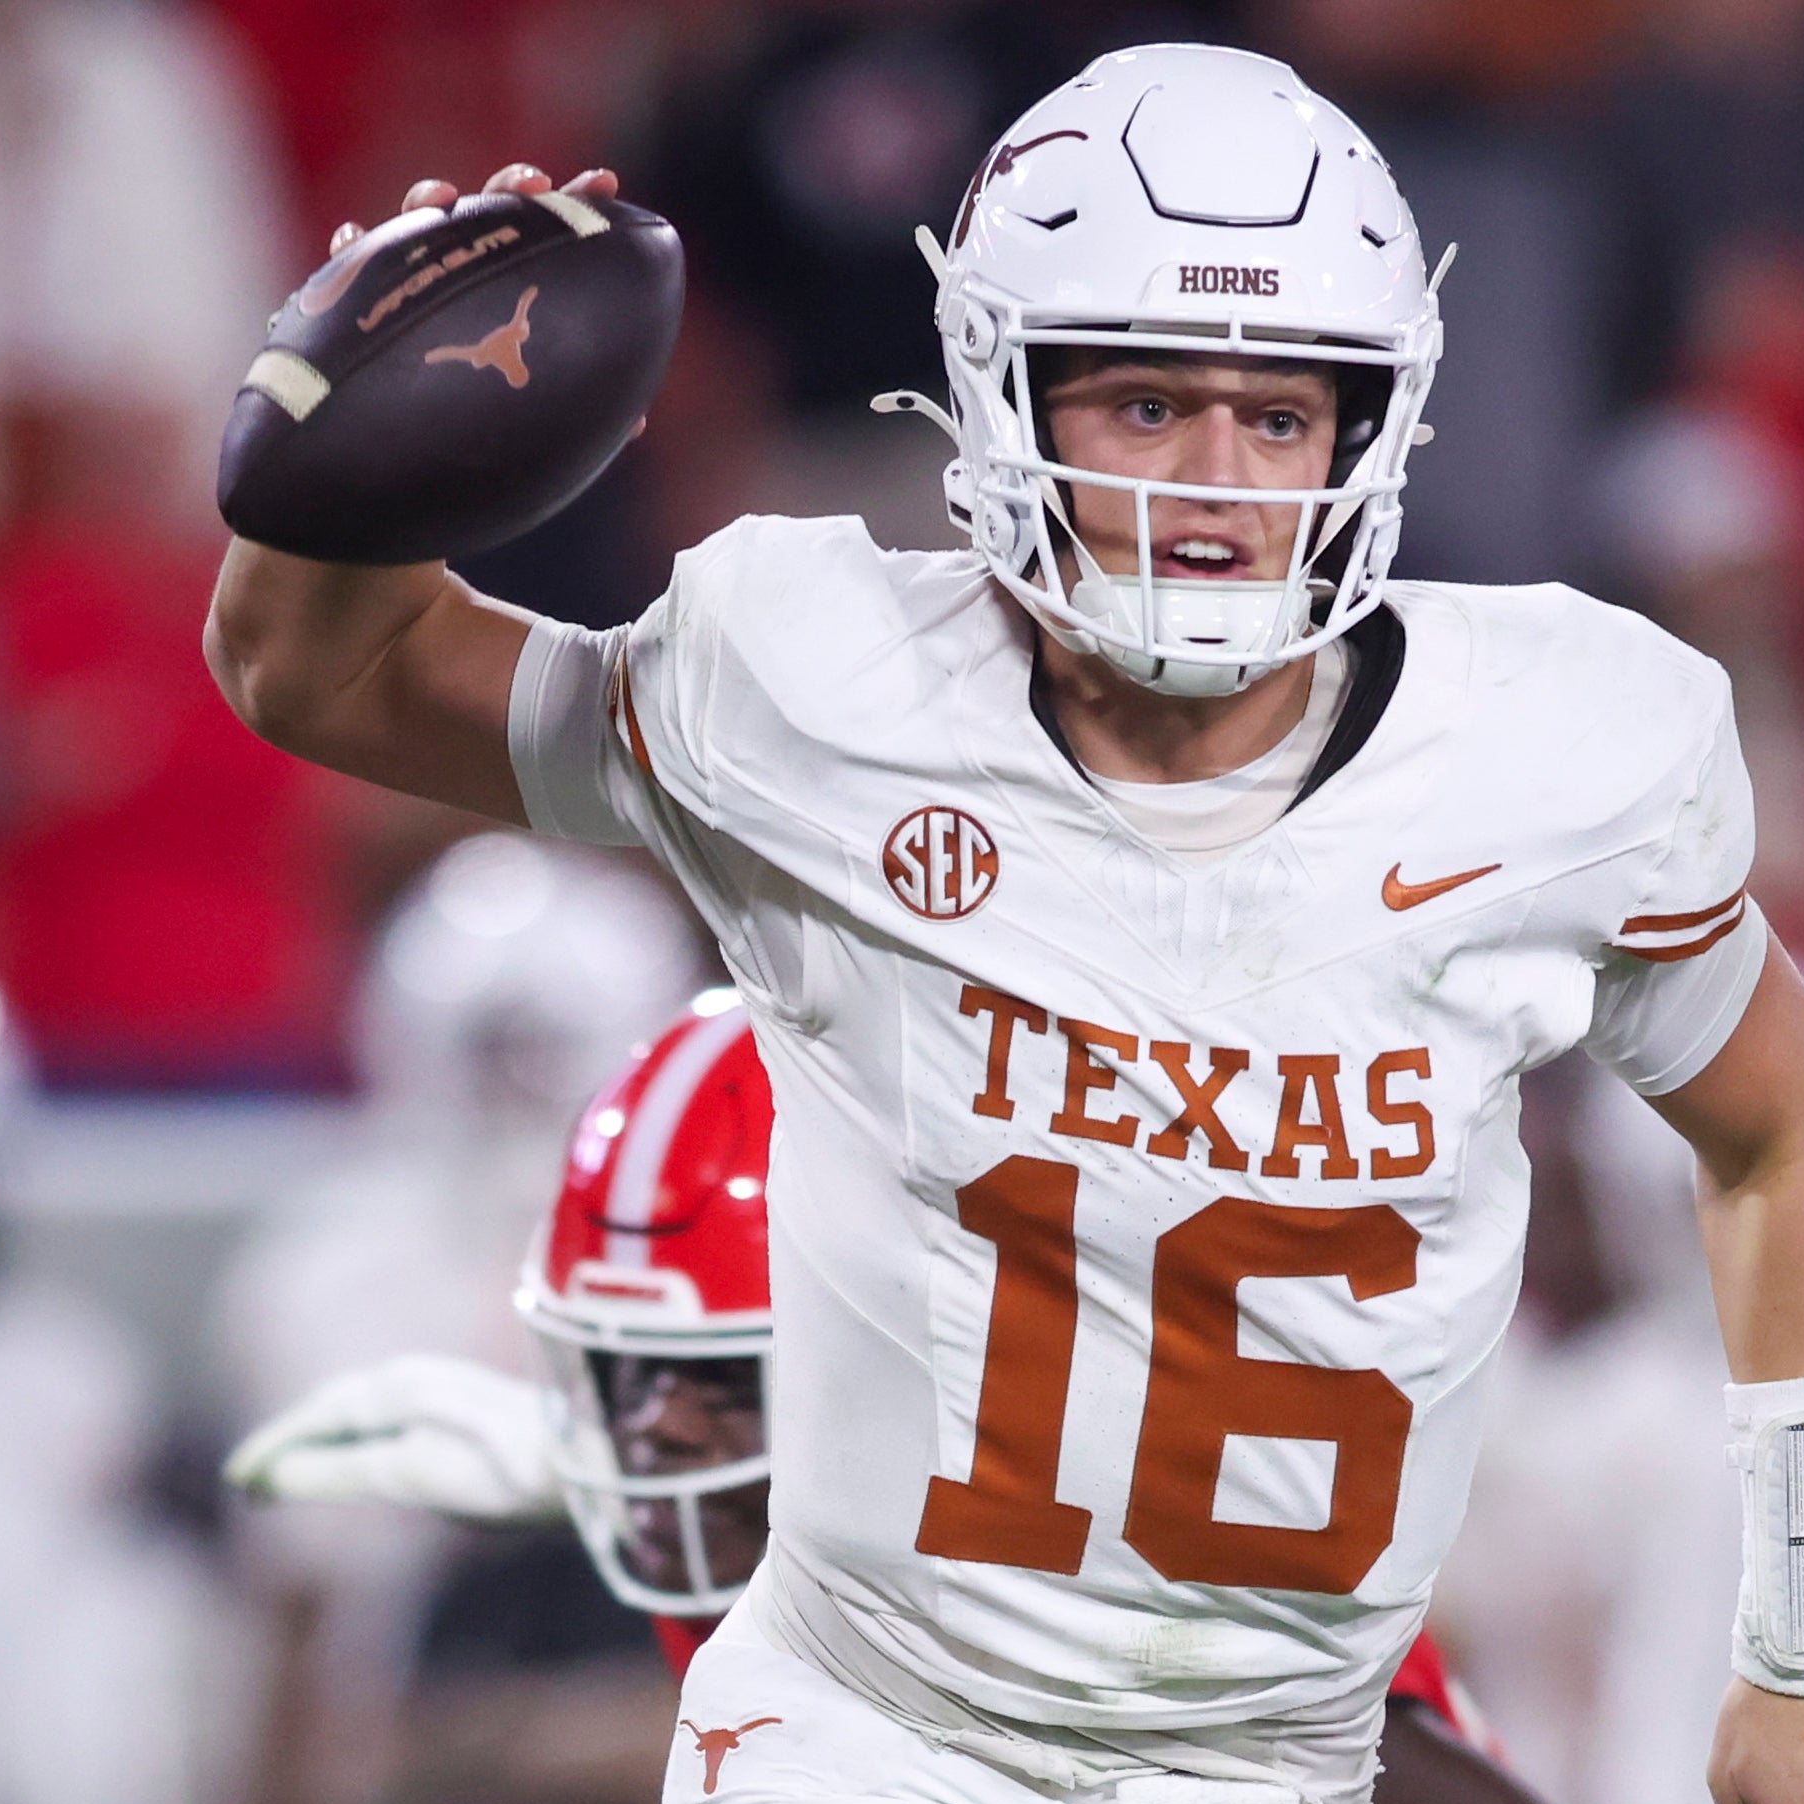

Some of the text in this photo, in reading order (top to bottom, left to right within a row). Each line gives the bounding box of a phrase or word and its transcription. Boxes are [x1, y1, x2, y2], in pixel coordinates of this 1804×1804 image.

[1178, 265, 1279, 296] HORNS
[890, 811, 992, 915] SEC
[959, 983, 1436, 1181] TEXAS
[914, 1154, 1422, 1596] 16
